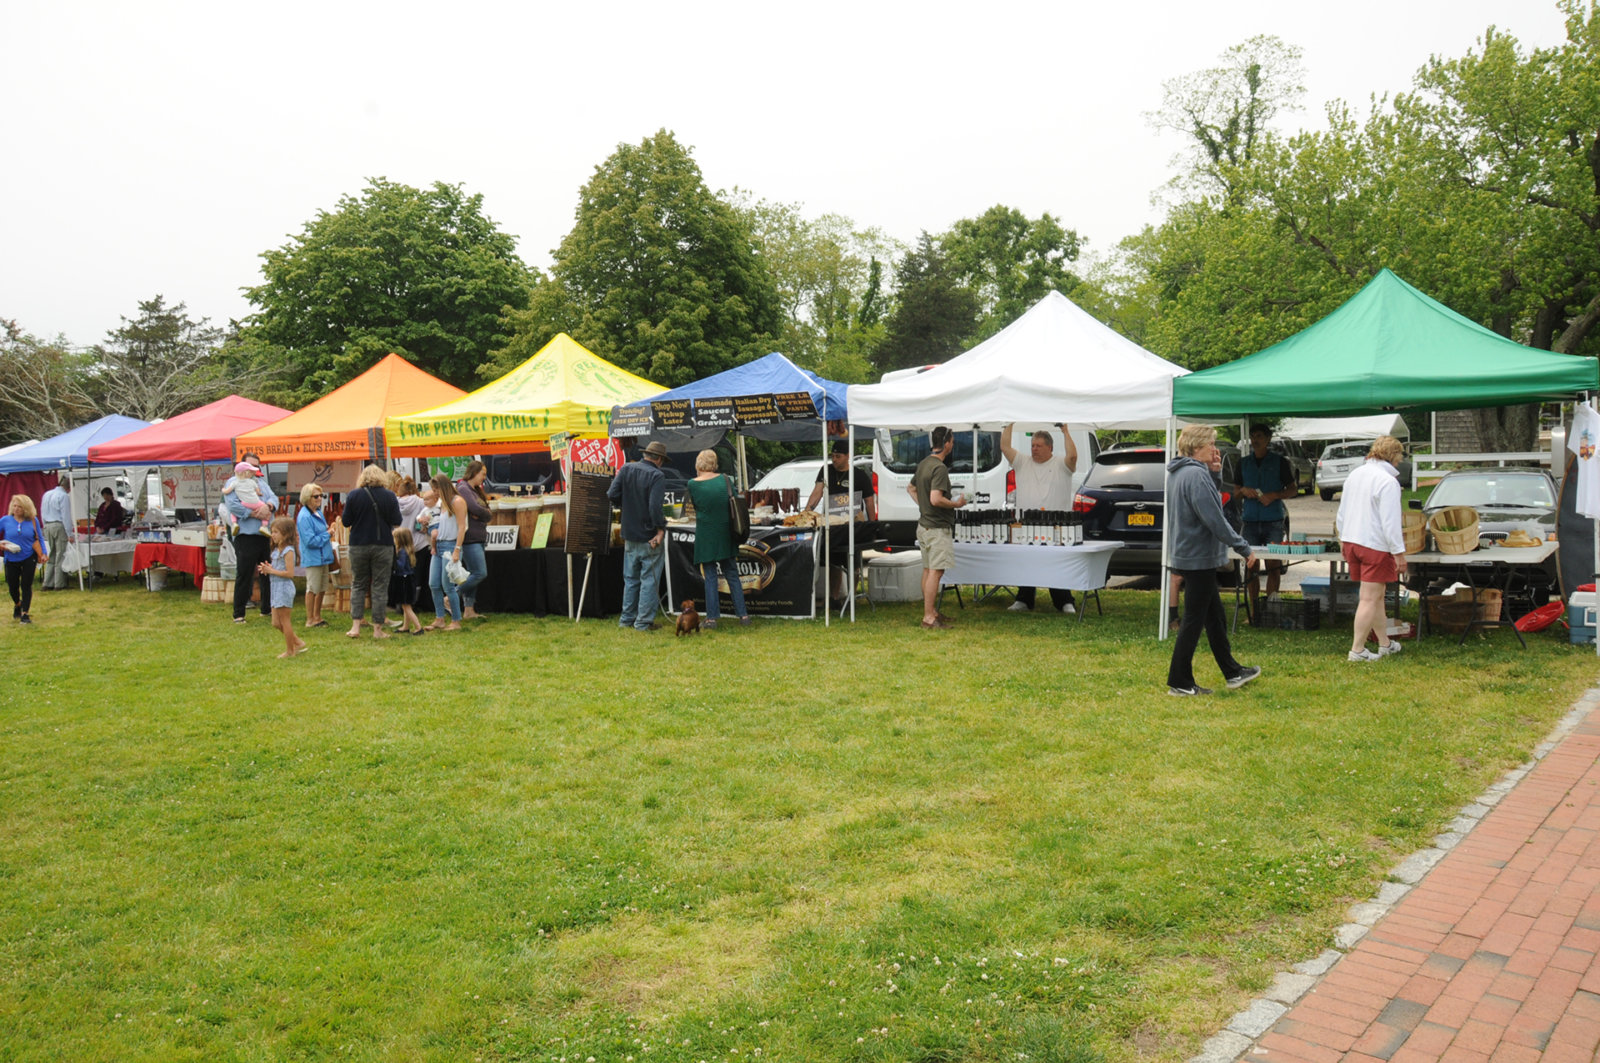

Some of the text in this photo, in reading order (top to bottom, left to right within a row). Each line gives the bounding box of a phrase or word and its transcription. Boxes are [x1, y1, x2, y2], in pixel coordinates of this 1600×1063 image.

[694, 400, 733, 408] Homemade
[759, 397, 772, 405] Dry
[598, 410, 613, 425] TH
[697, 419, 732, 427] Gravies
[408, 414, 538, 438] THE PERFECT PICKLE
[266, 444, 293, 455] BREAD
[303, 441, 323, 453] ELI'S
[324, 440, 357, 452] PASTRY
[574, 461, 615, 476] RAVIOLI
